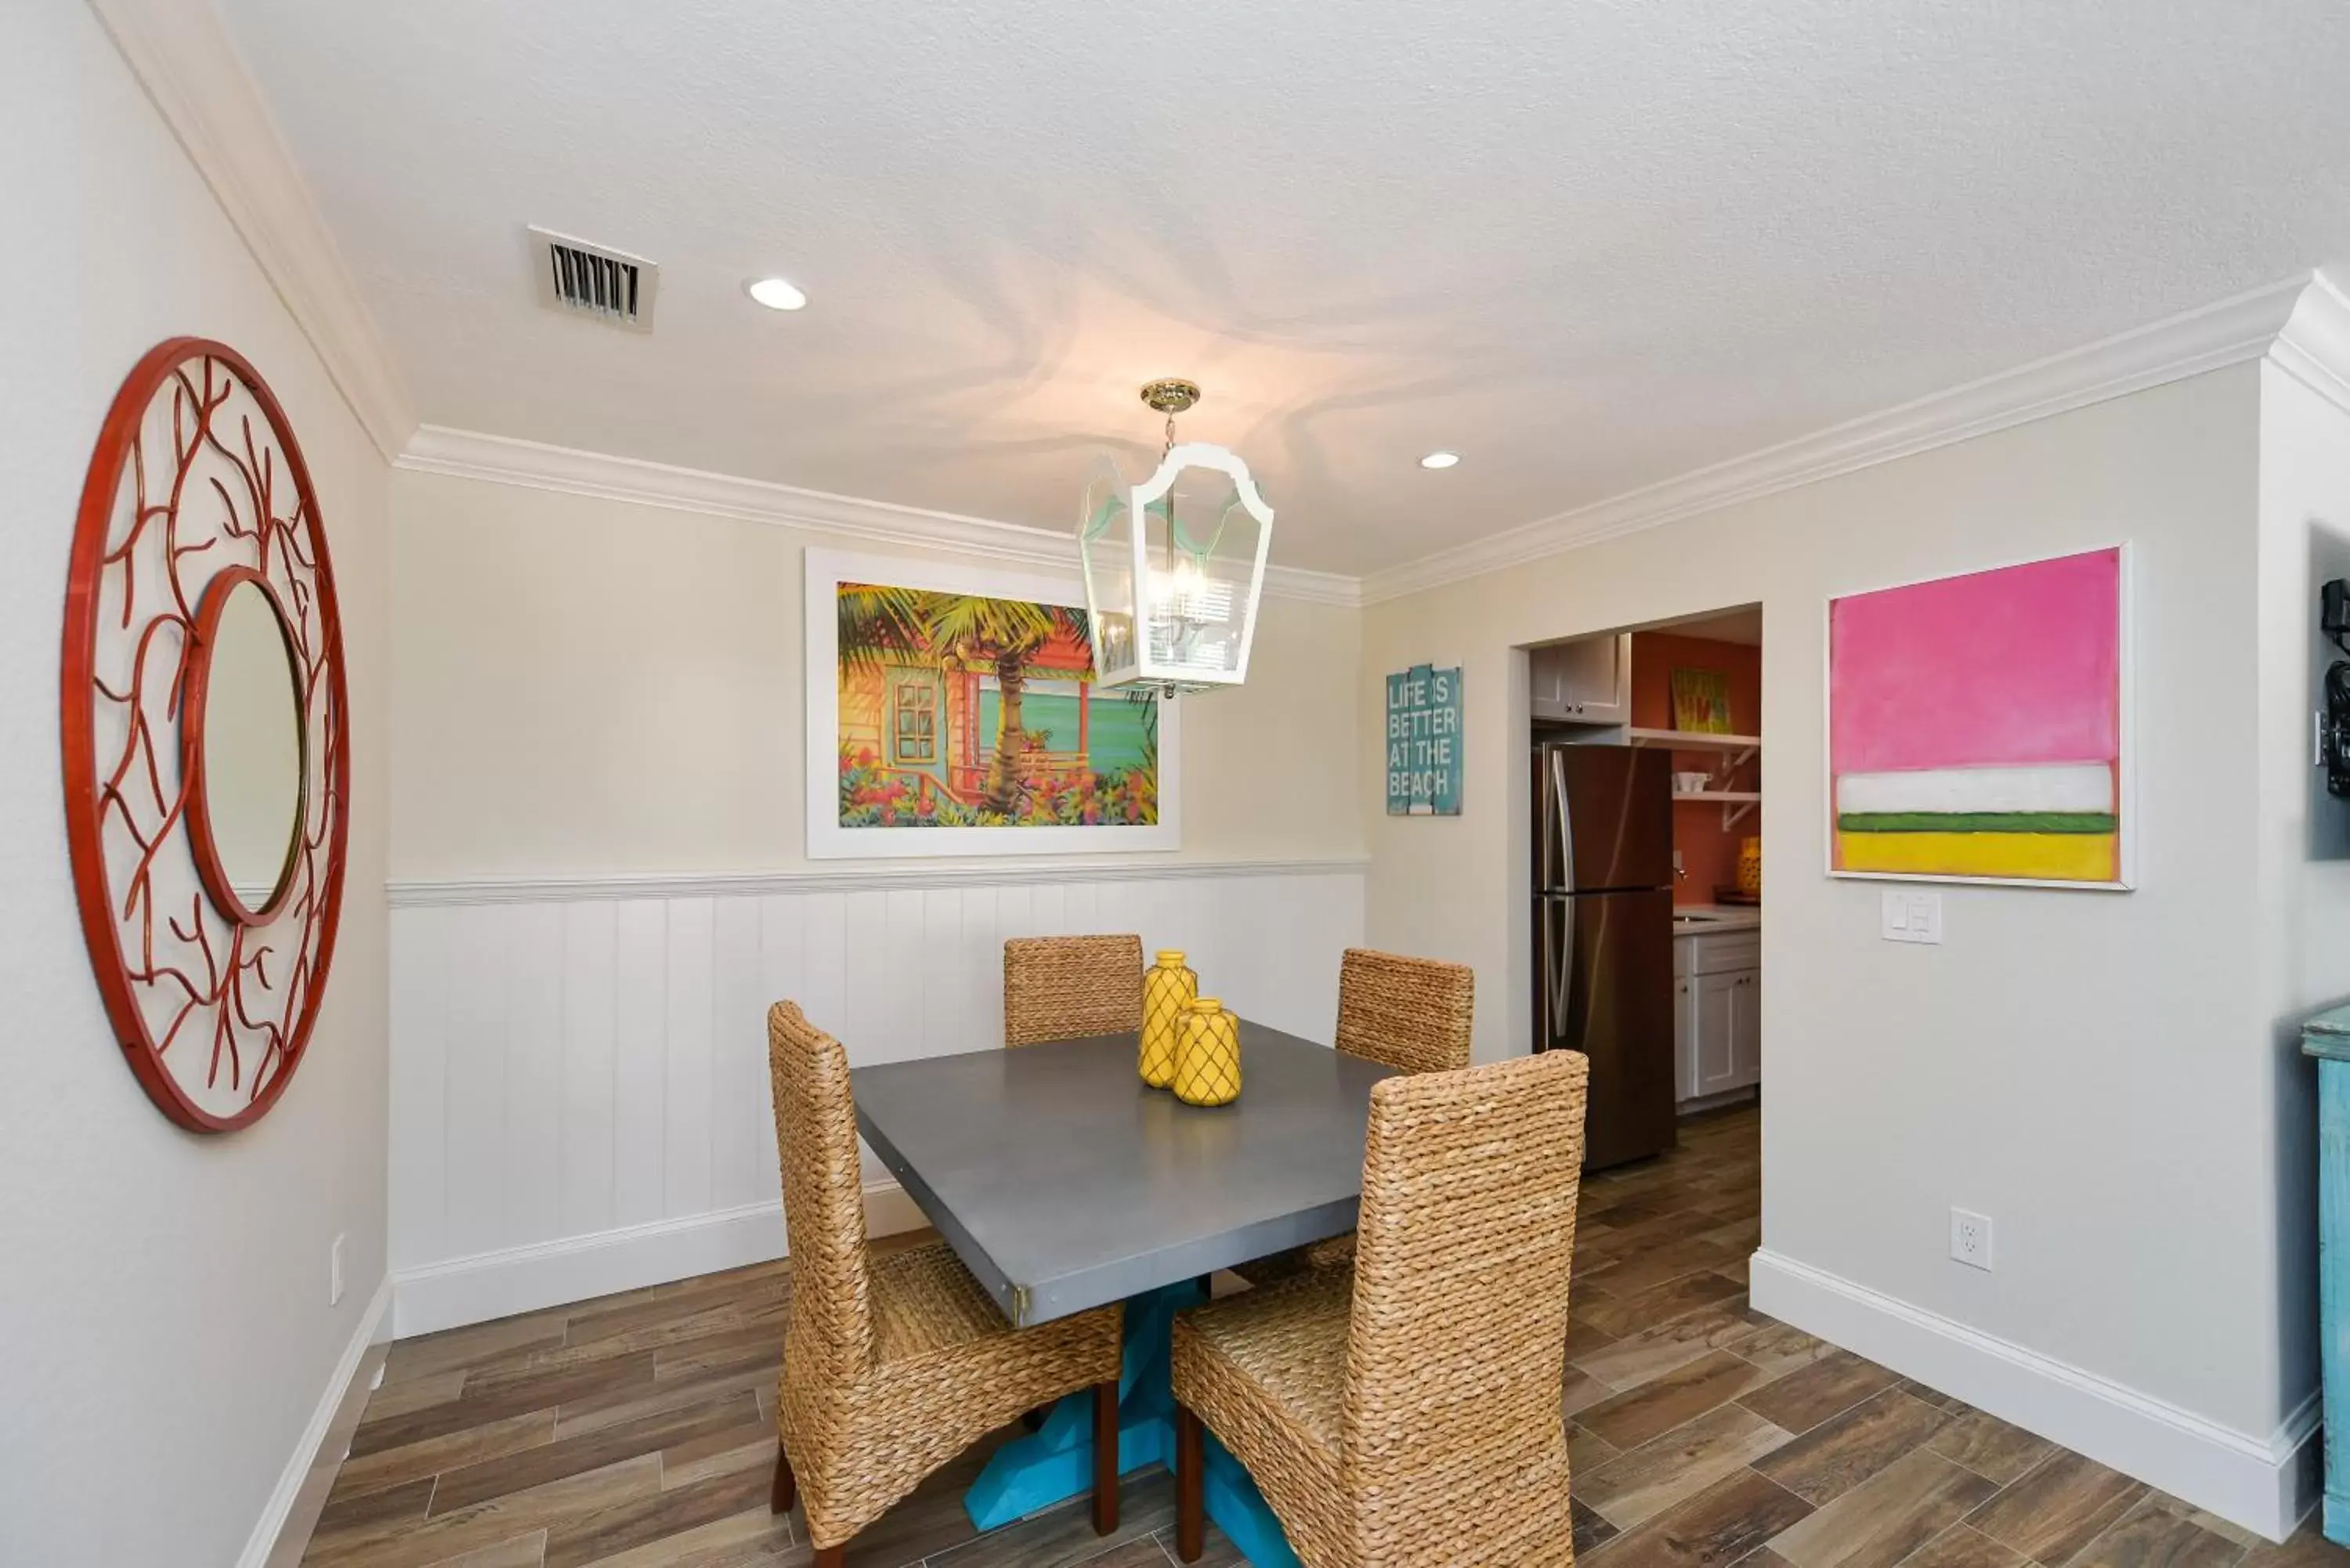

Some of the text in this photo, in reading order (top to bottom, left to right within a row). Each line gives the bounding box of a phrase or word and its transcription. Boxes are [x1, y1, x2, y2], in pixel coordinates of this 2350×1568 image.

[1389, 676, 1448, 709] LIFE IS
[1389, 708, 1455, 739] BETTER
[1389, 739, 1451, 768] AT THE
[1389, 769, 1448, 797] BEACH
